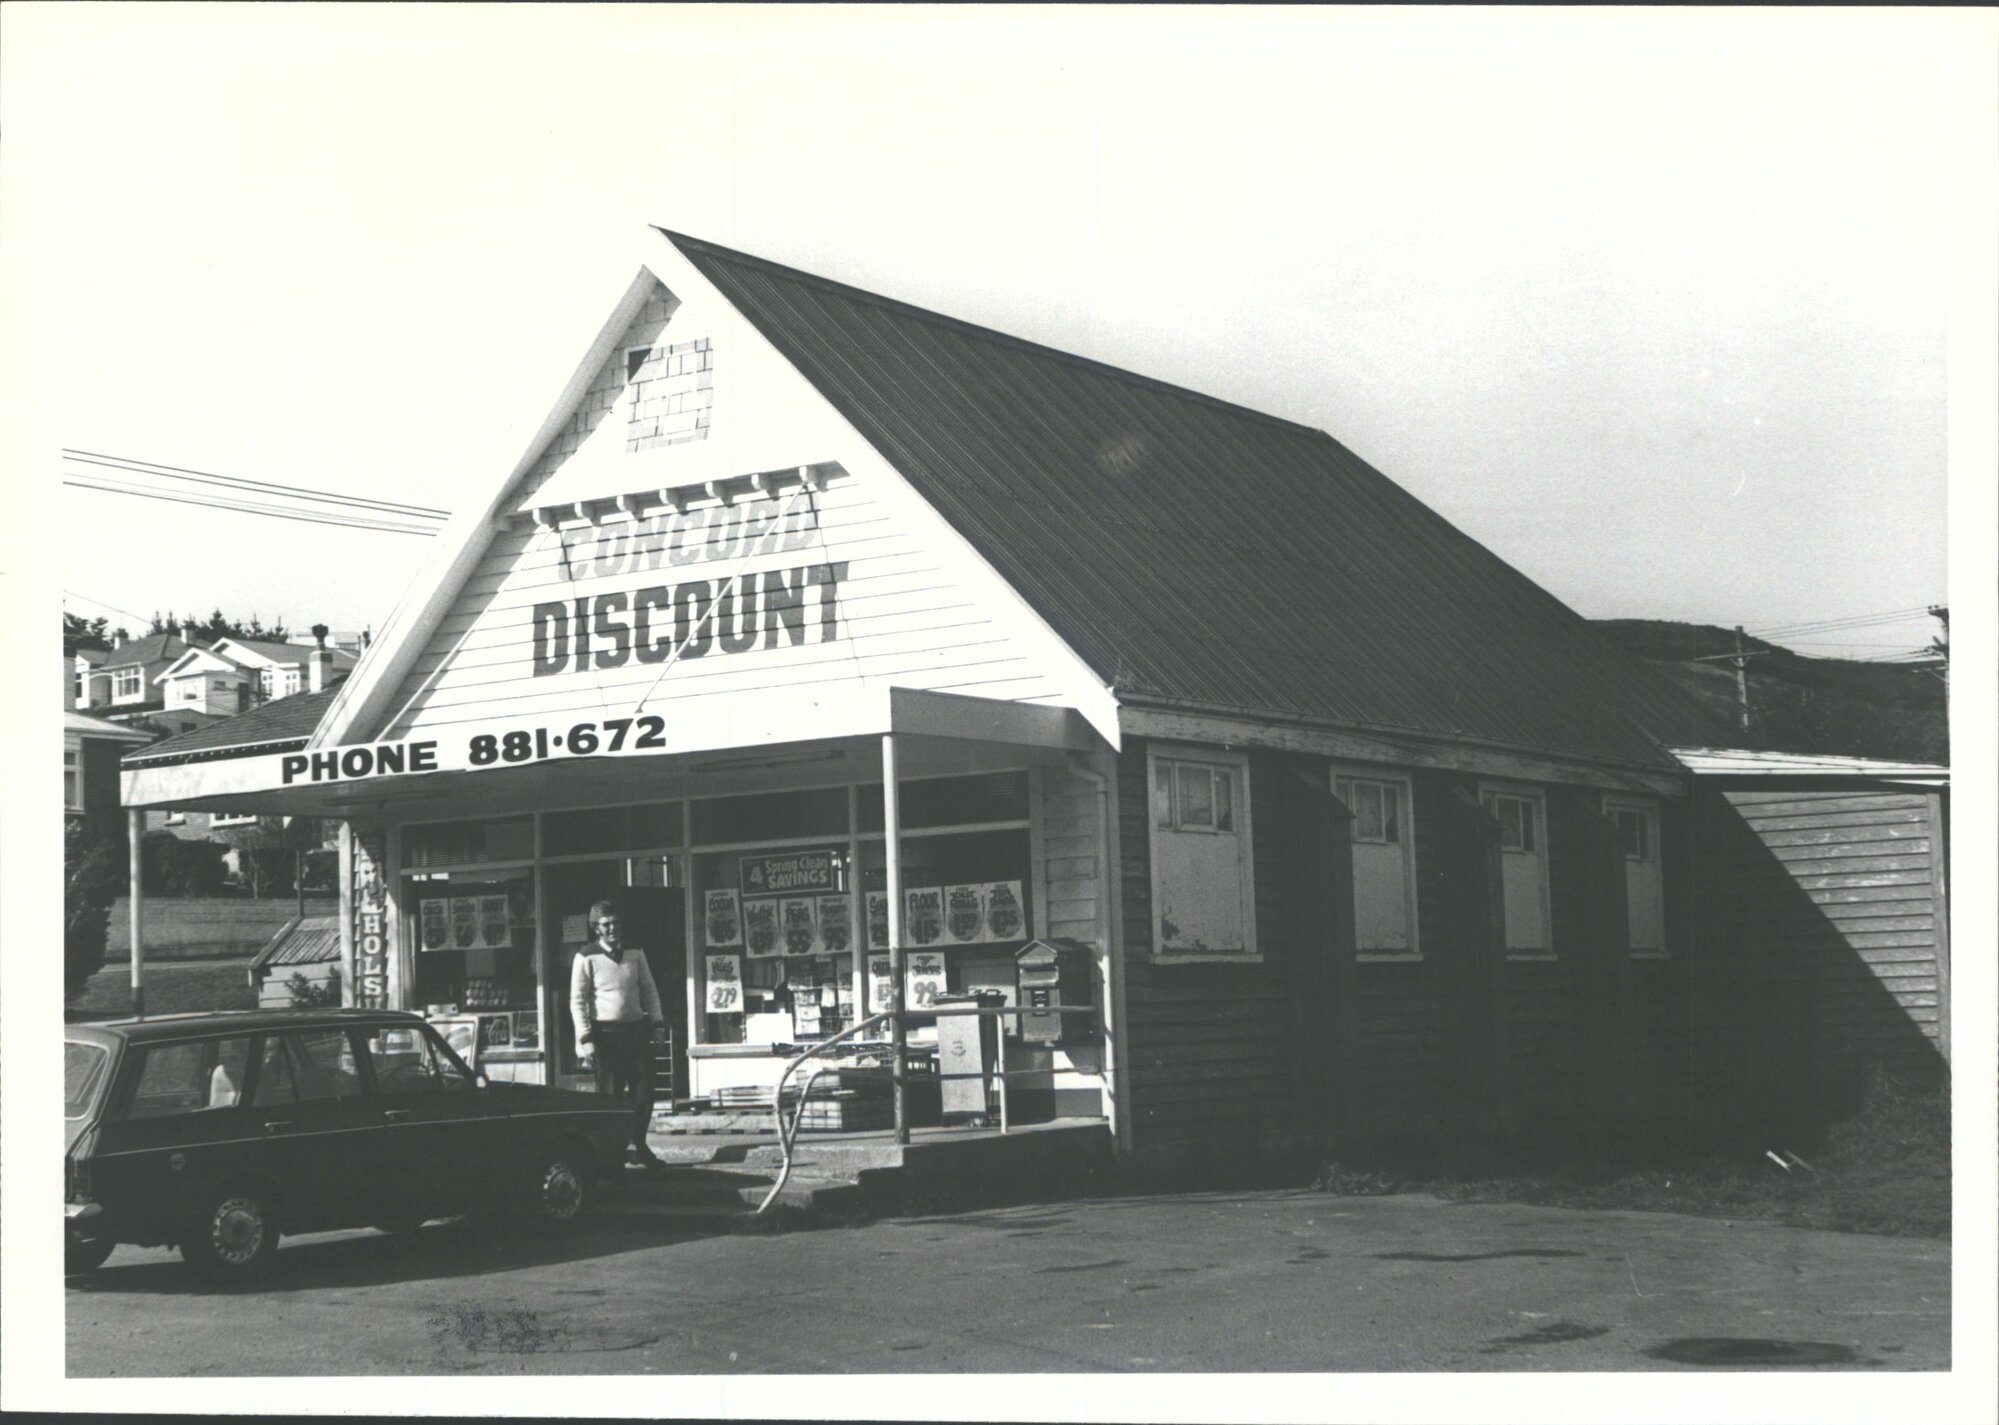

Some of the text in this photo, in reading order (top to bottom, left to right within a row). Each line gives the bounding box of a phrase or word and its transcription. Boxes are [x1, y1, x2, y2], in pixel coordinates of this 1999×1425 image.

[558, 491, 819, 581] CONCORD
[533, 561, 849, 678] DISCOUNT
[282, 741, 438, 784] PHONE
[750, 866, 764, 884] 4
[799, 856, 828, 869] Clean
[768, 869, 828, 889] SAVINGS
